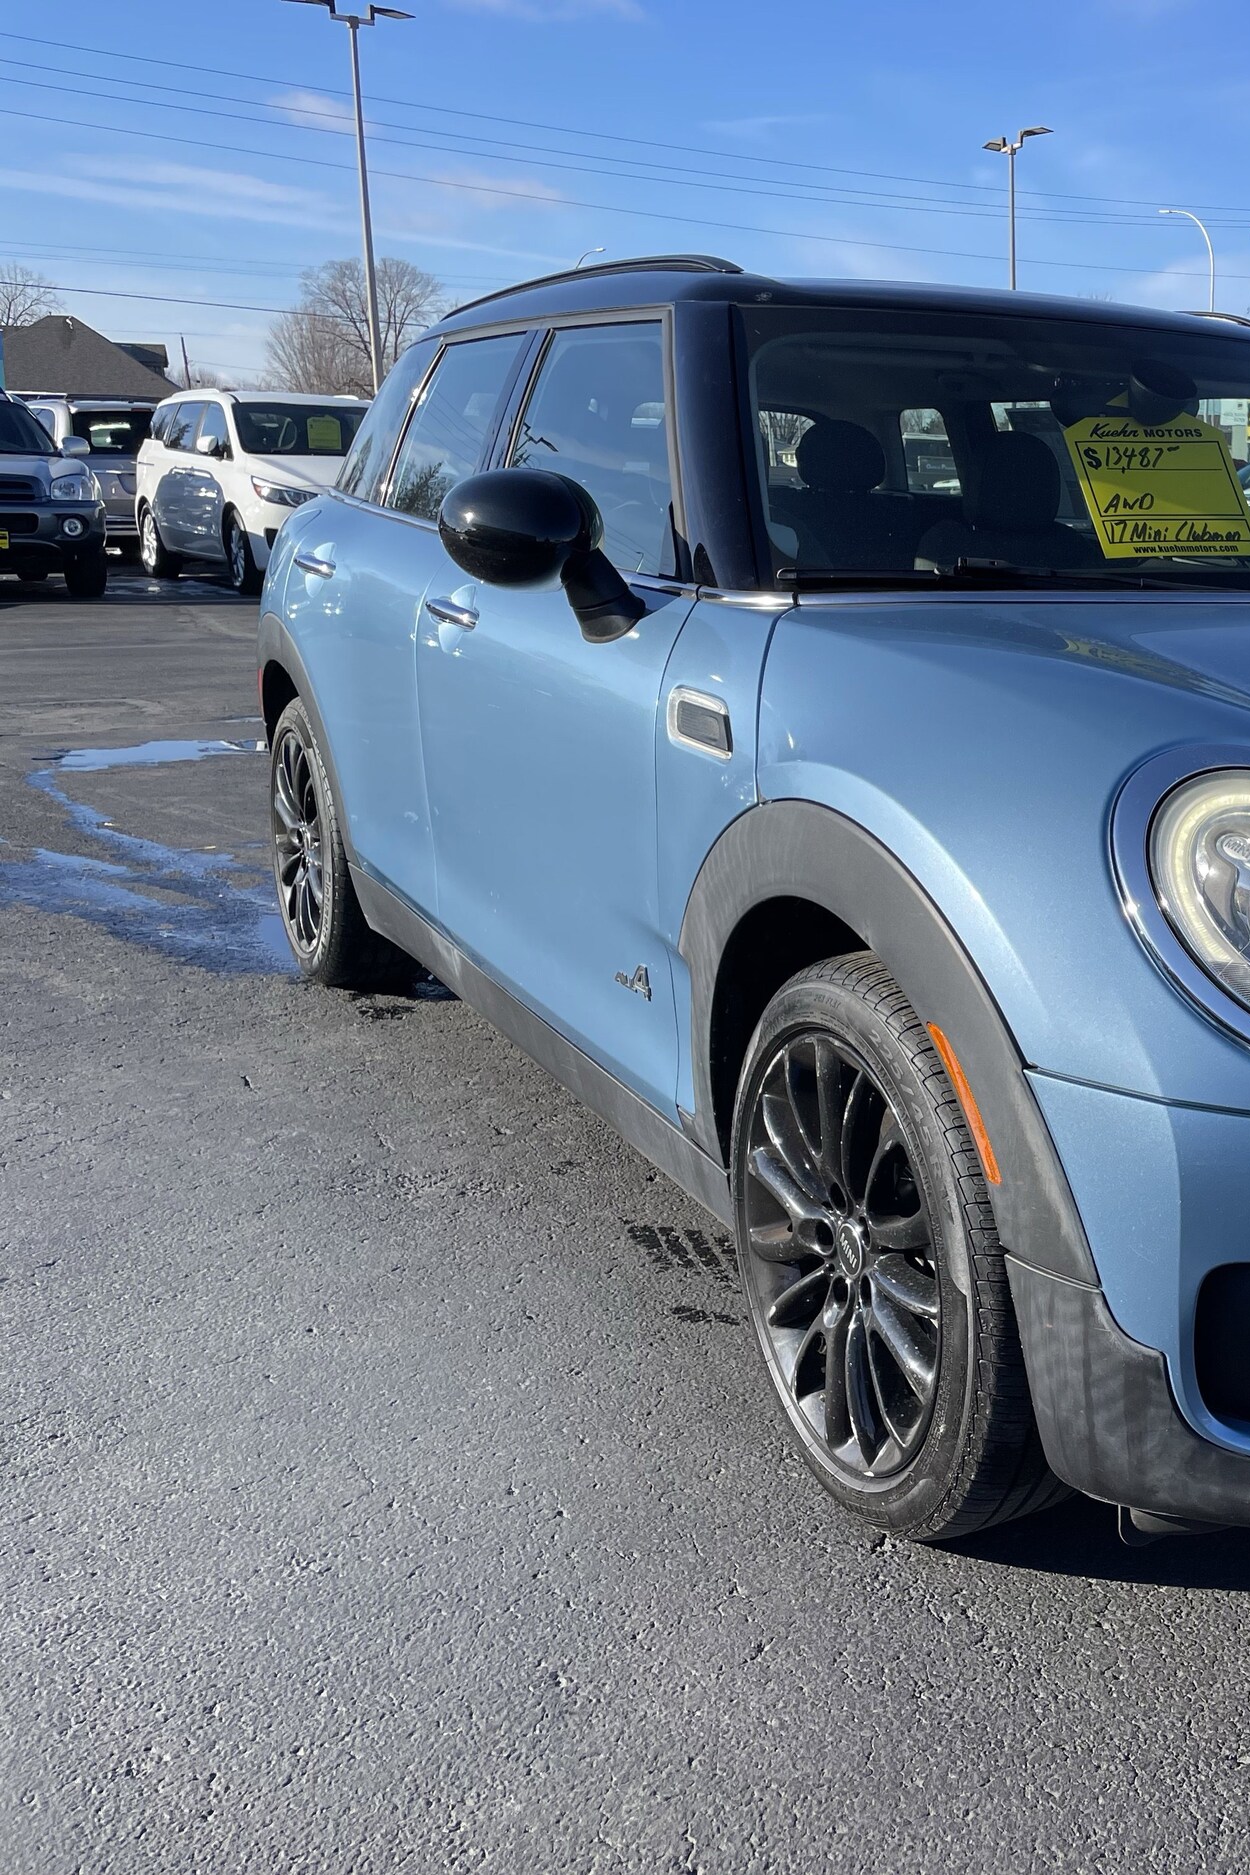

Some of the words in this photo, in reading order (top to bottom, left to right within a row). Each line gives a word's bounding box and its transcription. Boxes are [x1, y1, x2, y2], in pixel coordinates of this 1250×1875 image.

[1090, 423, 1140, 439] Kuehn
[1143, 428, 1203, 438] MOTORS
[1110, 520, 1127, 543] 17
[1130, 522, 1169, 542] Mini
[1175, 521, 1241, 542] Clubman
[1133, 545, 1239, 554] www.kuehnmotors.com
[840, 1232, 857, 1269] MINI
